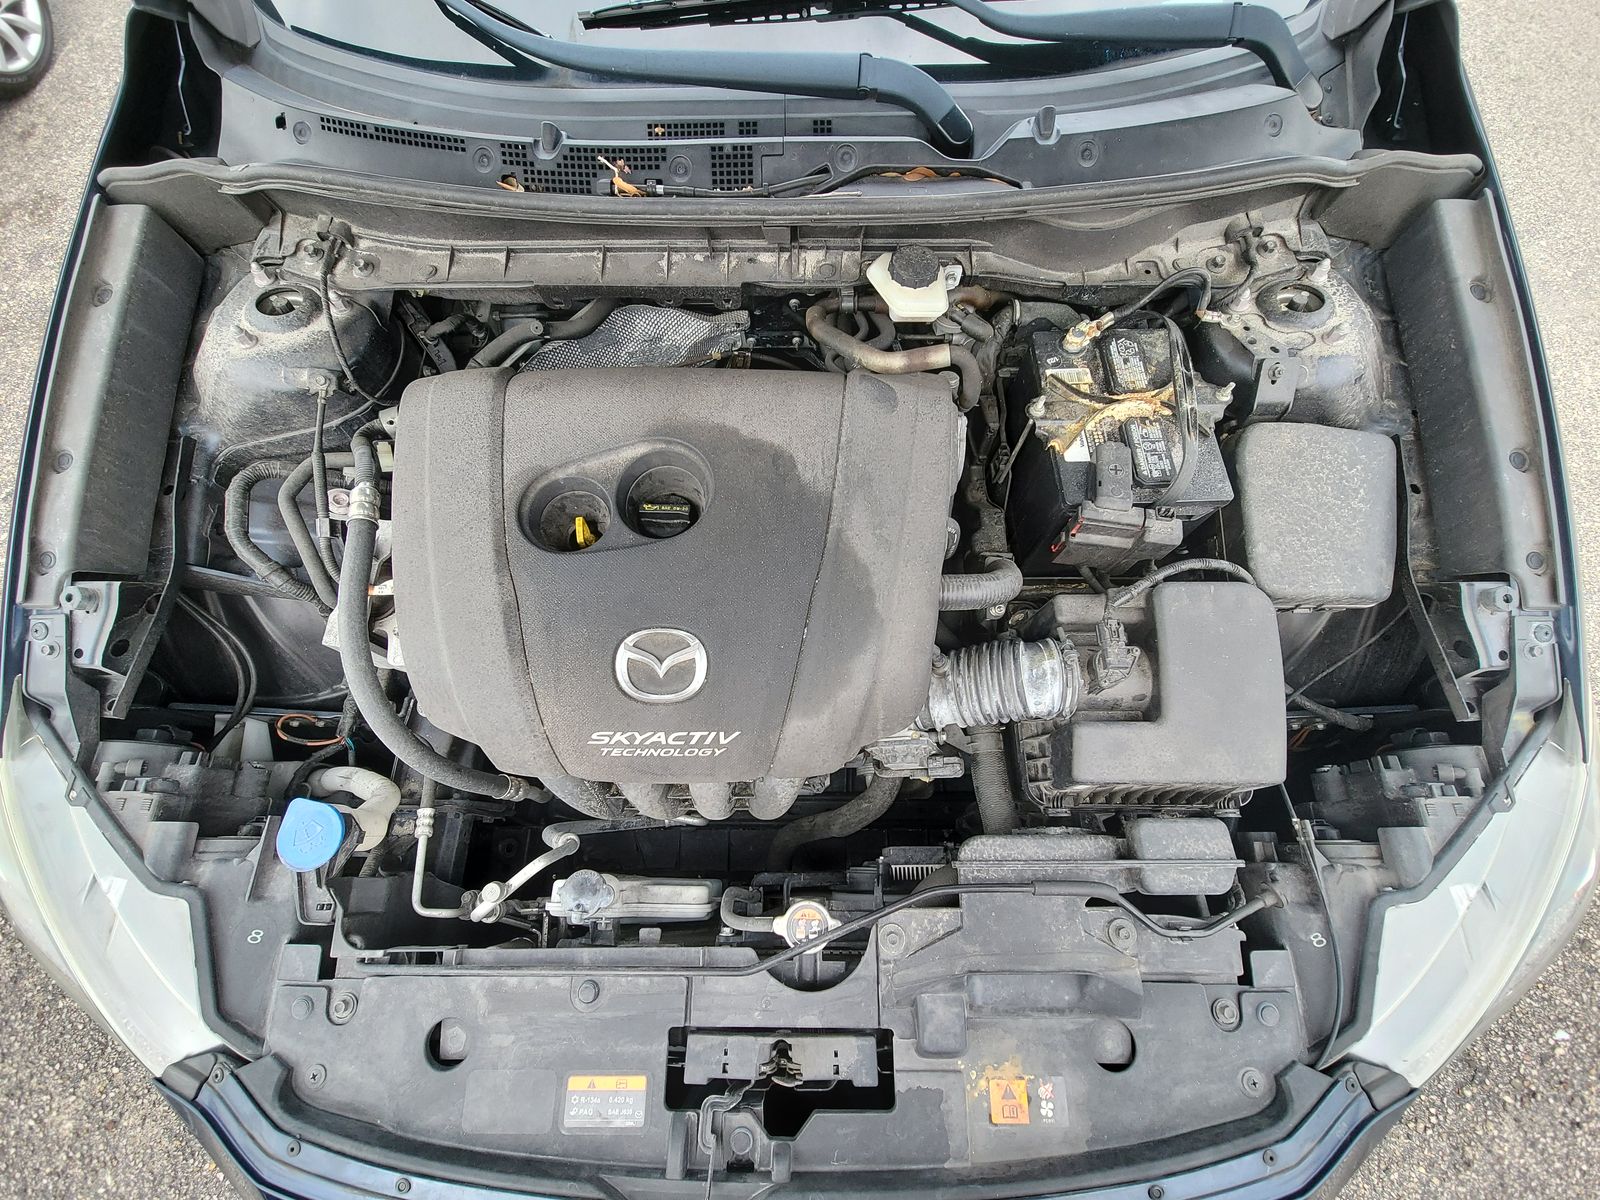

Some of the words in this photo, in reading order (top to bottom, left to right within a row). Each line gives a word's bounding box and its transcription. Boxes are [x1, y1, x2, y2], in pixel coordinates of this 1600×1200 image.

[587, 731, 742, 745] SKYACTIV
[600, 747, 728, 757] TECHNOLOGY
[247, 929, 264, 944] 8
[1310, 932, 1327, 947] 8
[580, 1096, 601, 1104] R-134a
